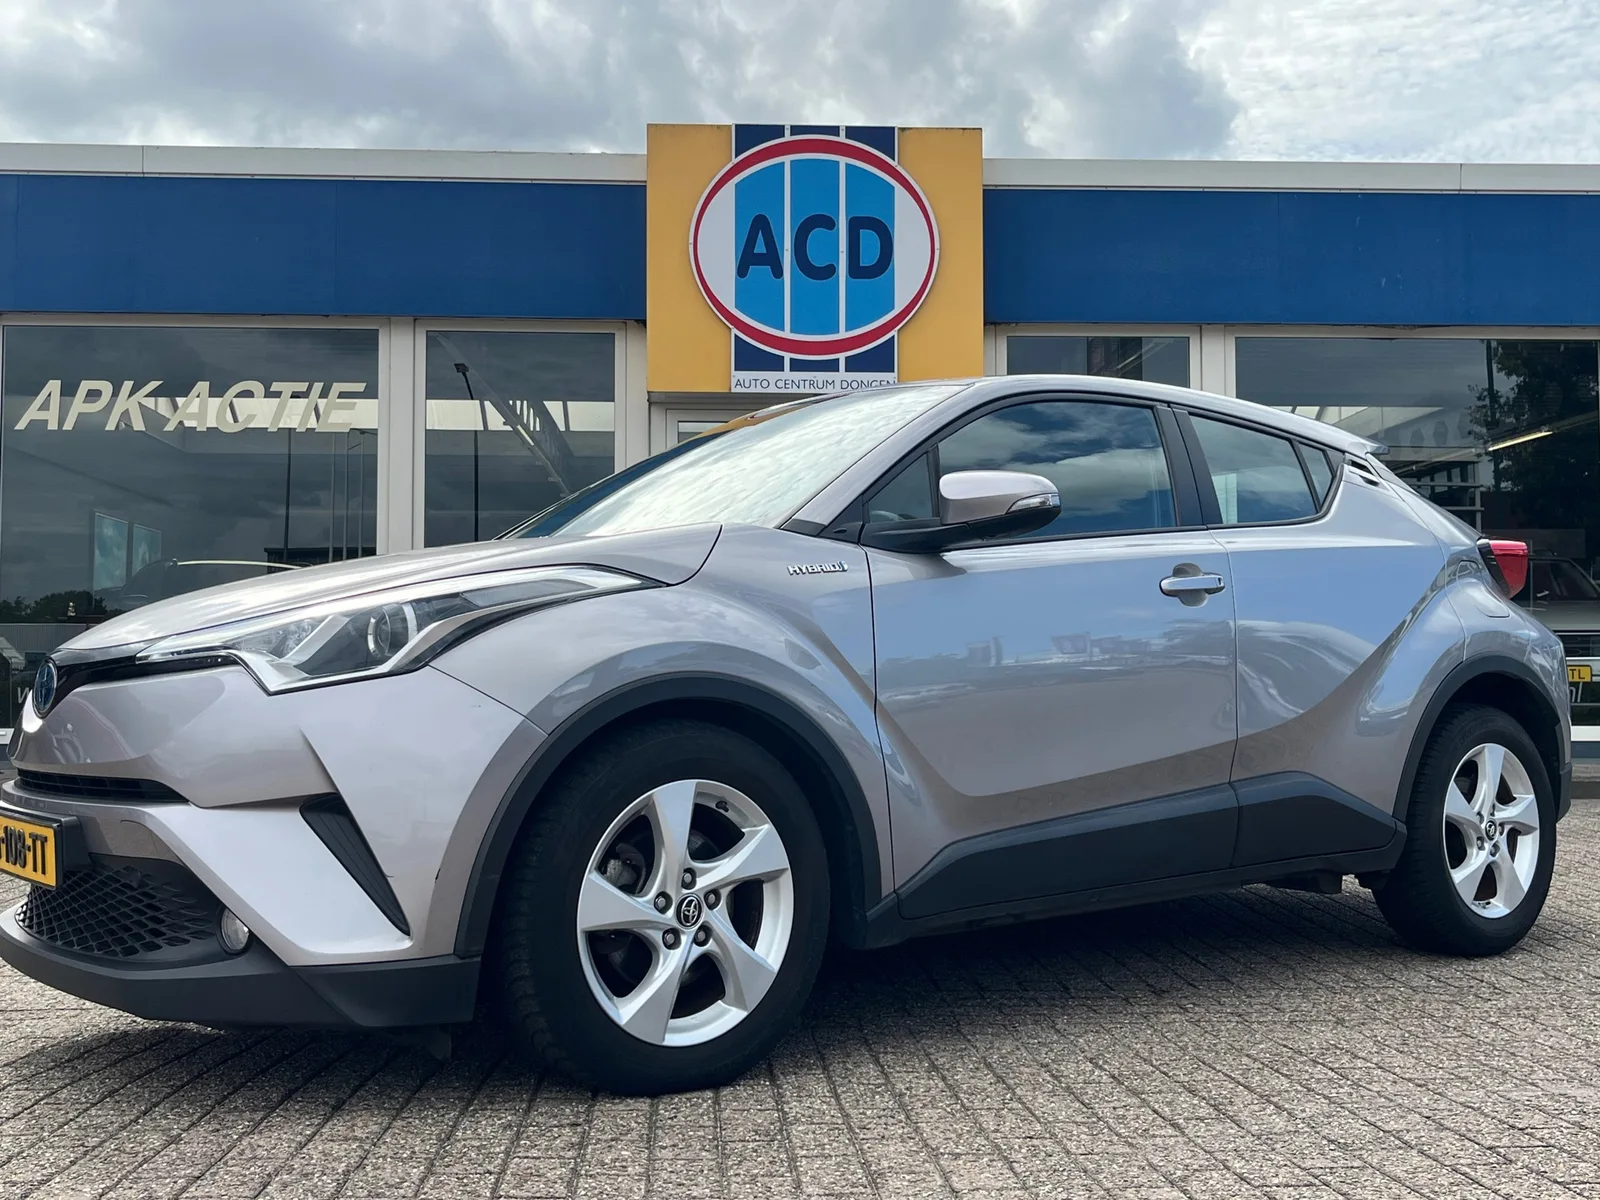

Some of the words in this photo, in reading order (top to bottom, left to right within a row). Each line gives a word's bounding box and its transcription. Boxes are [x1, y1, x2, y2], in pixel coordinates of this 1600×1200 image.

[736, 213, 894, 281] ACD
[14, 379, 163, 431] APK
[164, 381, 367, 433] ACTIE
[734, 379, 770, 389] AUTO
[775, 379, 835, 389] CENTRUM
[787, 562, 841, 576] HYBRID
[0, 825, 48, 875] -108-TT
